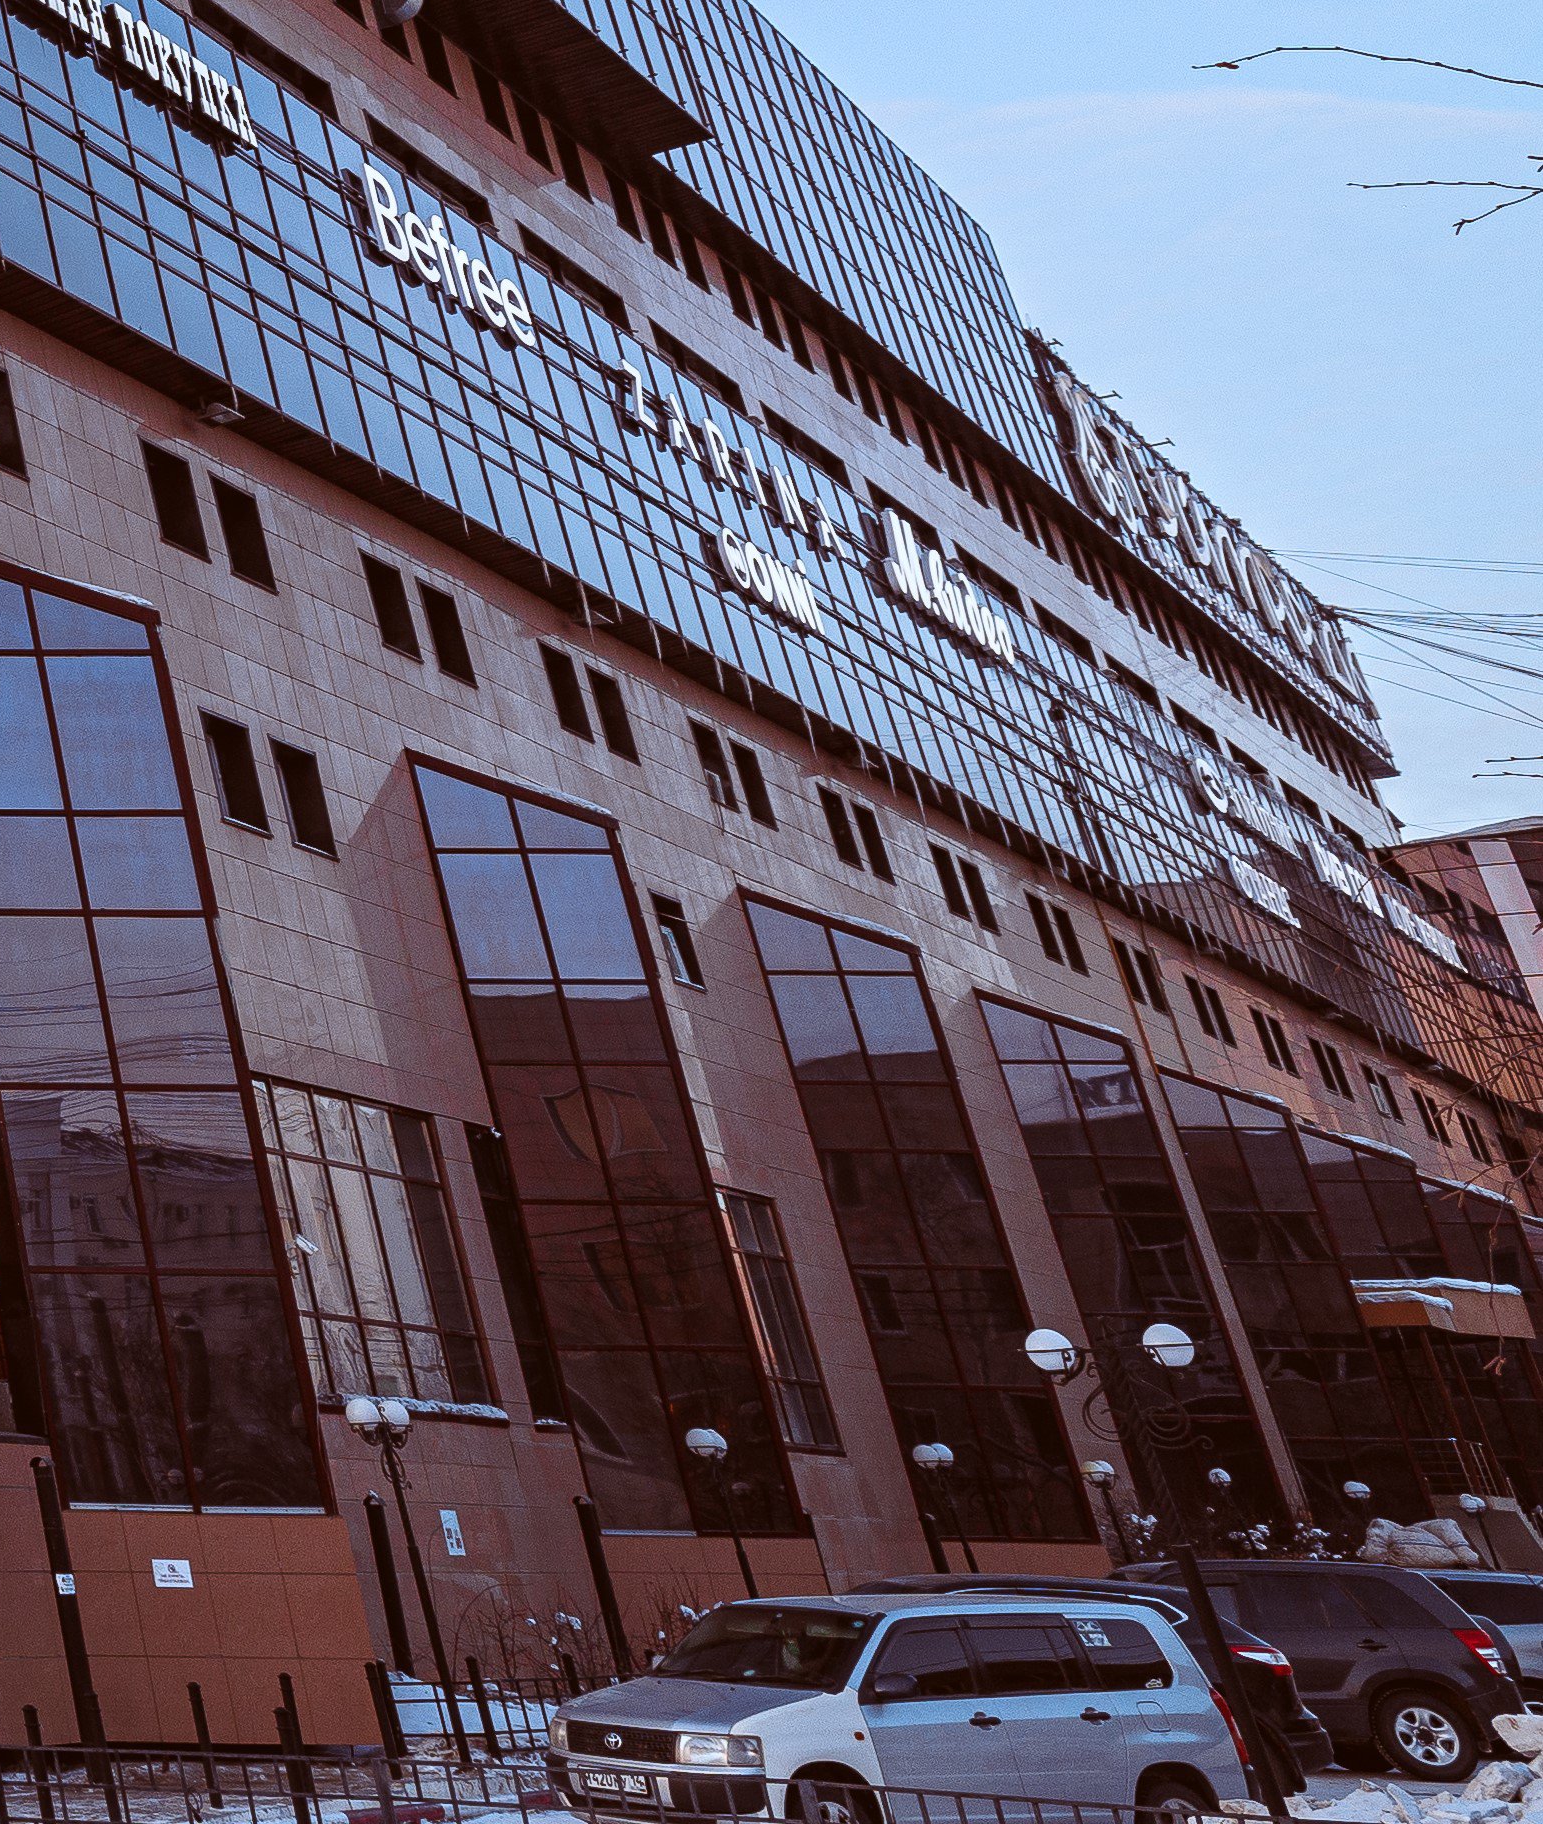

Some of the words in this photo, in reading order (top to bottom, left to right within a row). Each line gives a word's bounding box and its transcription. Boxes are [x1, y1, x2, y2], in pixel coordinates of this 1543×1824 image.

[112, 2, 259, 148] ПОКУПКА
[363, 163, 536, 347] Befree
[618, 358, 846, 558] ZARINA
